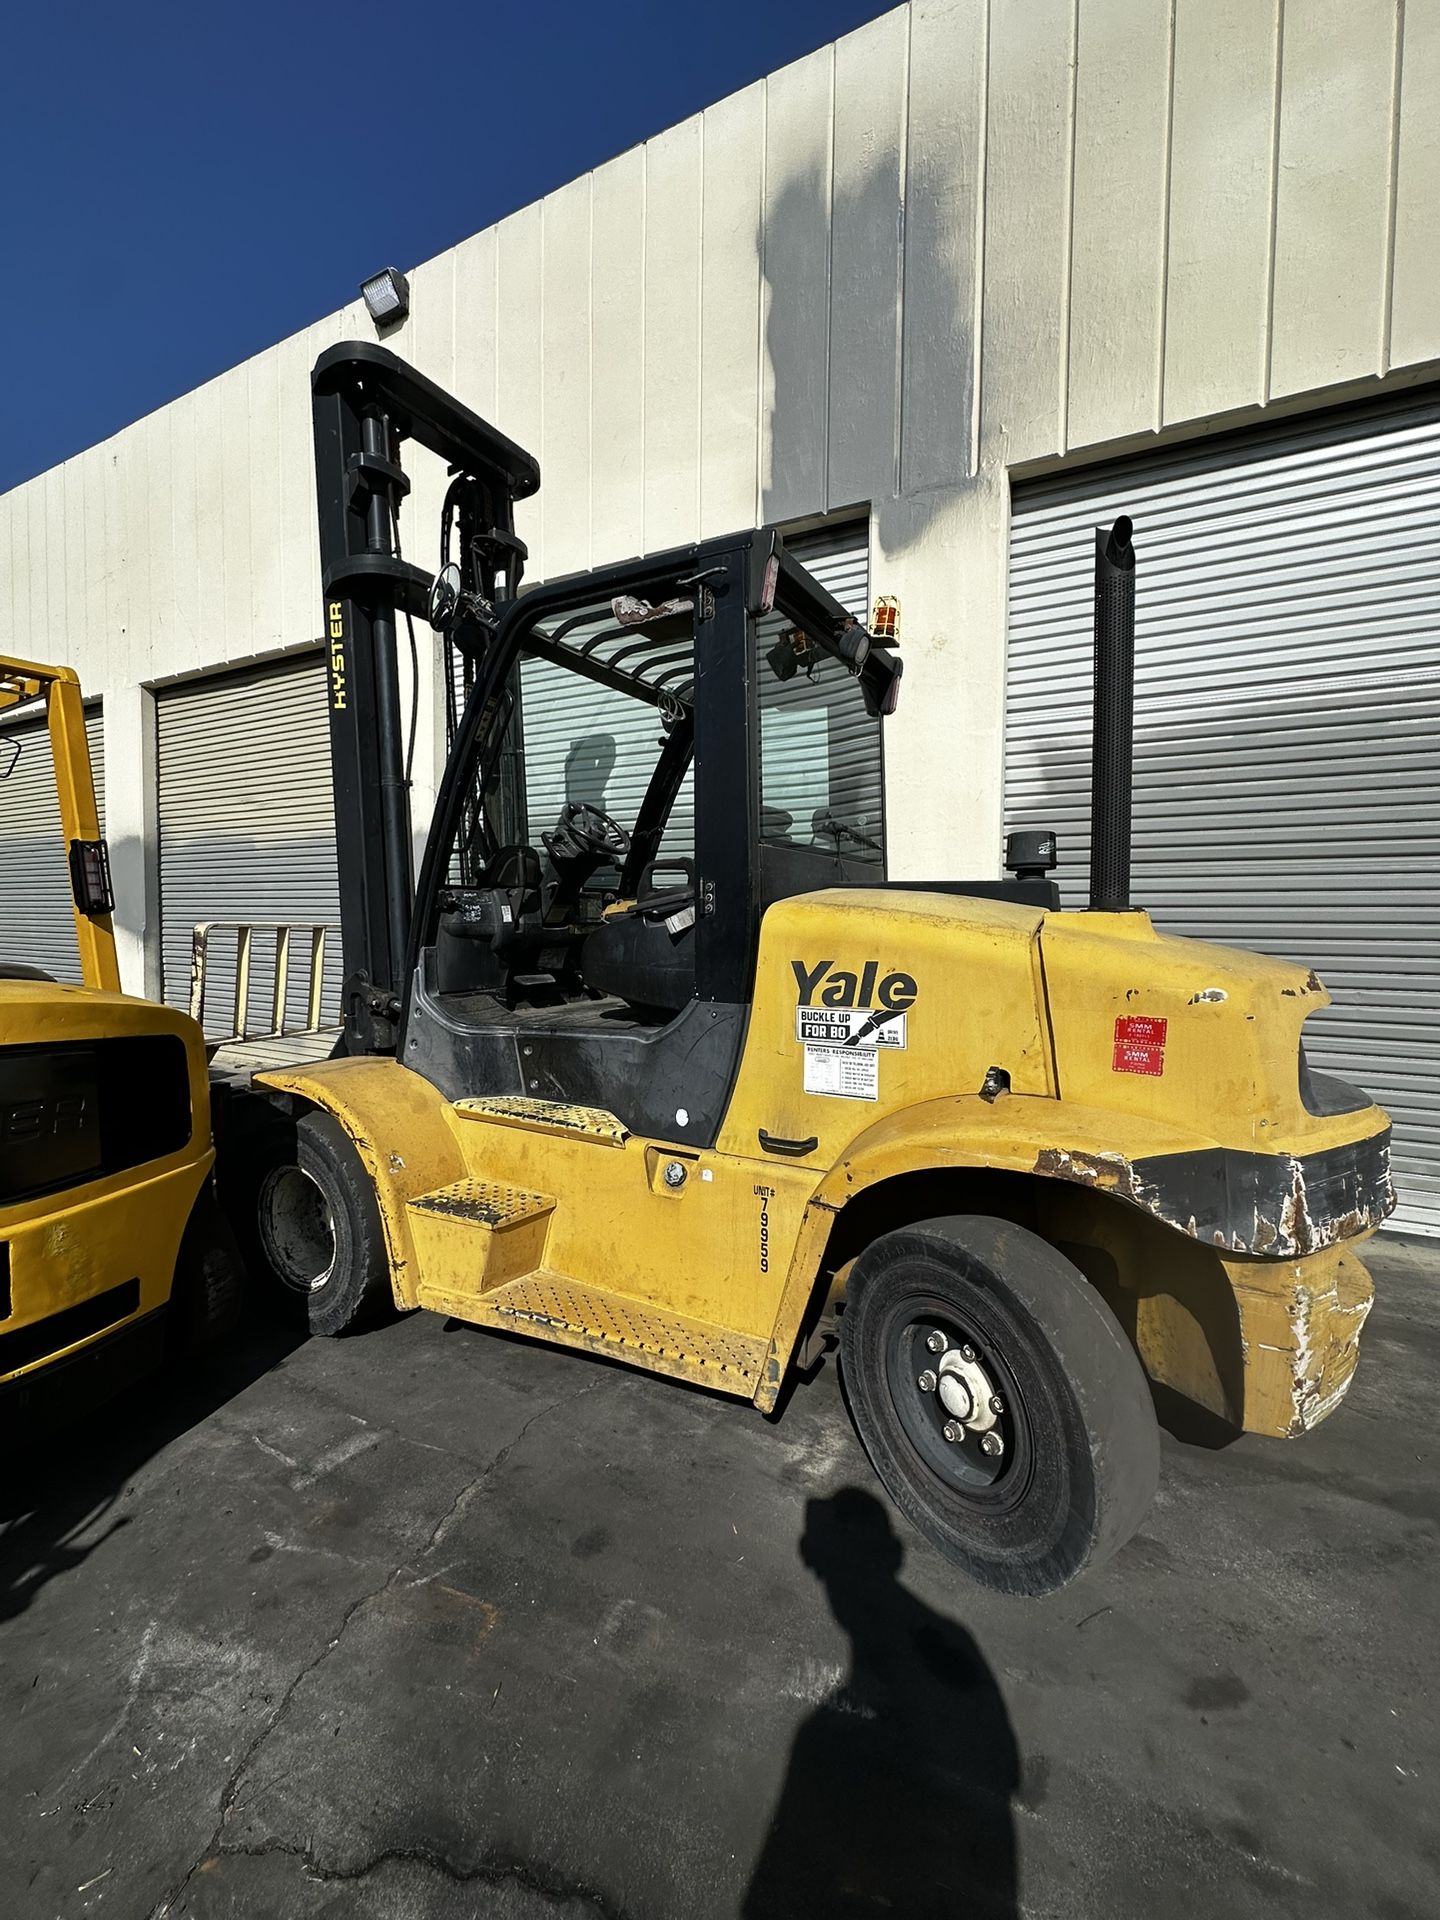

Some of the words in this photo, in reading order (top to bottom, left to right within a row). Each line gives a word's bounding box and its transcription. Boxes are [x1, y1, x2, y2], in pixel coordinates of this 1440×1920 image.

[329, 602, 347, 709] HYSTER
[791, 961, 918, 1010] Yale
[801, 1011, 836, 1023] BUCKLE
[838, 1013, 851, 1023] UP
[805, 1024, 827, 1038] FOR
[830, 1025, 846, 1039] BO
[1127, 1027, 1154, 1035] RENTAL
[807, 1046, 830, 1054] RENTERS
[832, 1049, 875, 1058] RESPONSIBILITY
[753, 1184, 776, 1198] UNIT#
[760, 1197, 769, 1273] 79959
